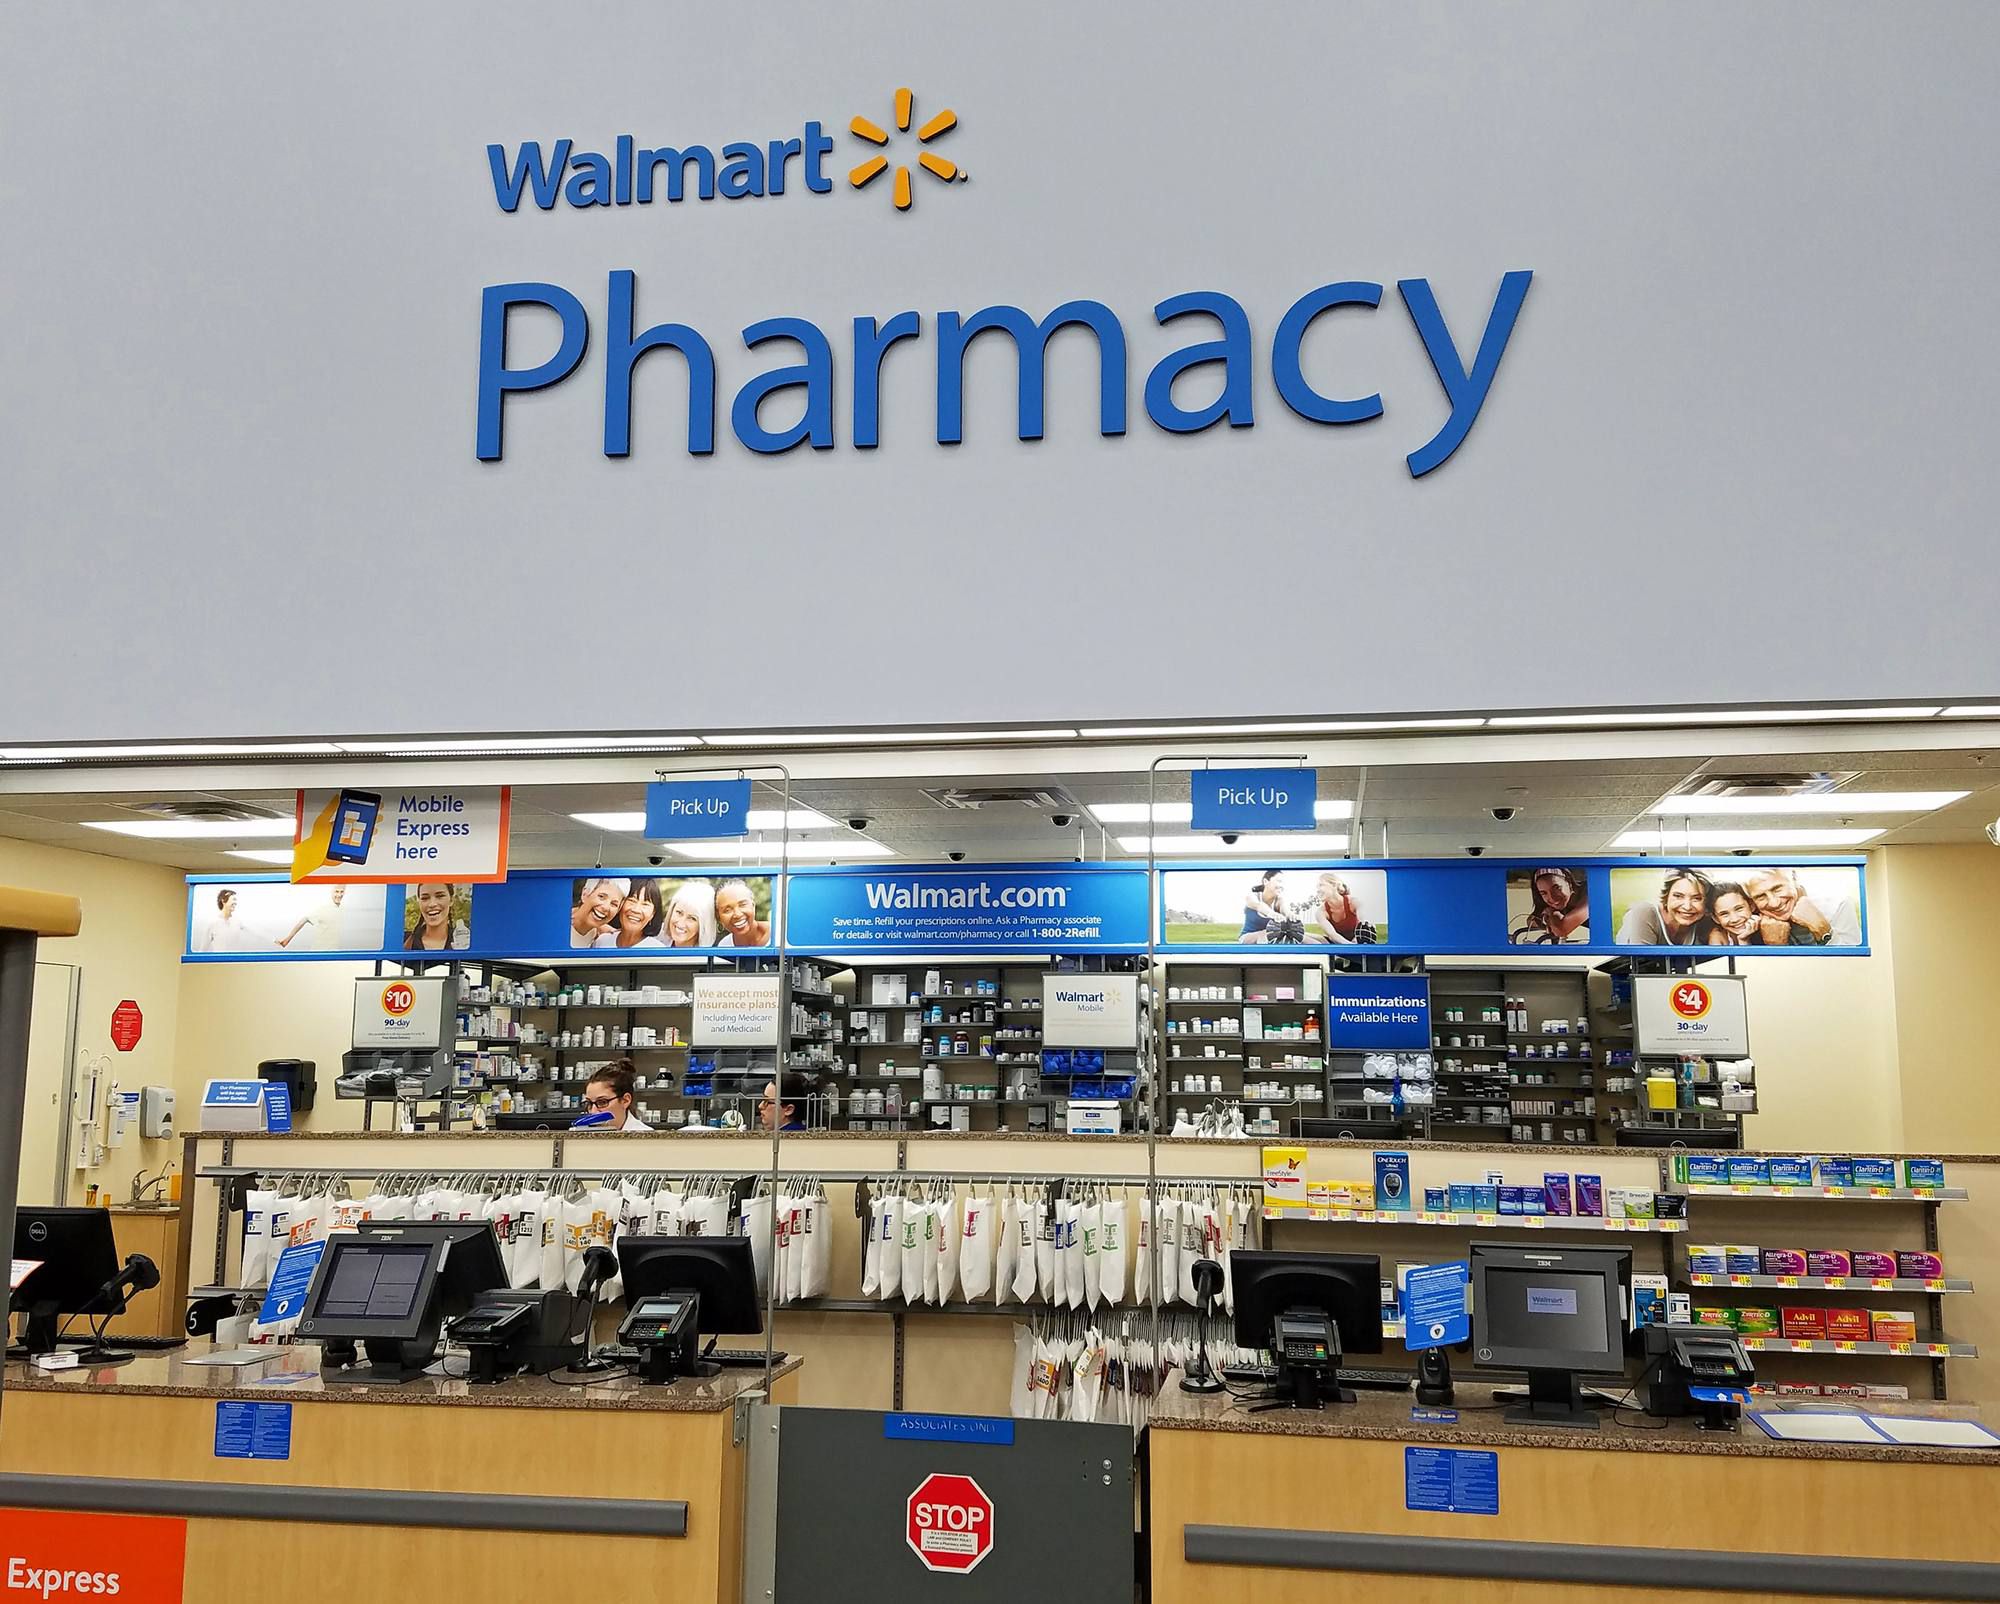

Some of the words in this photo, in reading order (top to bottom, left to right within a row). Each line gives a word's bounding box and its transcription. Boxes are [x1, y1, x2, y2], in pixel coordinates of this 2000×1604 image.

[487, 120, 833, 212] Walmart
[476, 268, 1534, 479] Pharmacy
[399, 794, 464, 812] Mobile
[1218, 788, 1256, 805] Pick
[1261, 788, 1288, 809] Up
[671, 798, 703, 815] Pick
[707, 798, 729, 818] Up
[396, 818, 470, 841] Express
[396, 842, 439, 859] here
[865, 881, 1067, 909] Walmart.com
[833, 917, 852, 926] Save
[853, 917, 873, 926] time.
[874, 916, 894, 926] Refill
[895, 918, 913, 928] your
[915, 916, 966, 927] prescriptions
[967, 915, 994, 925] online.
[996, 915, 1011, 925] Ask
[1020, 915, 1061, 927] Pharmacy
[1063, 915, 1102, 925] associate
[832, 930, 844, 940] for
[846, 930, 873, 940] details
[874, 932, 884, 940] or
[885, 930, 902, 939] visit
[903, 929, 1003, 941] walmart.com/pharmacy
[1004, 931, 1013, 939] or
[1015, 929, 1030, 939] call
[386, 990, 412, 1009] $10
[698, 989, 716, 998] We
[717, 990, 750, 1001] accept
[753, 990, 778, 998] most
[1055, 991, 1105, 1003] Walmart
[1330, 995, 1427, 1008] Immunizations
[1678, 988, 1703, 1010] $4
[697, 1000, 746, 1009] insurance
[1077, 1004, 1104, 1012] Mobile
[384, 1018, 411, 1028] 90-day
[702, 1013, 737, 1023] Including
[739, 1014, 772, 1022] Medicare
[1340, 1012, 1389, 1023] Available
[1392, 1012, 1418, 1023] Here
[711, 1025, 725, 1033] and
[727, 1025, 764, 1033] Medicaid.
[1677, 1022, 1708, 1032] 30-day
[731, 1190, 737, 1209] 2
[1532, 1295, 1564, 1303] Walmart
[189, 1311, 197, 1329] 5
[1793, 1313, 1816, 1321] Advil
[1836, 1315, 1859, 1323] Advil
[915, 1502, 985, 1531] STOP
[8, 1557, 120, 1600] Express
